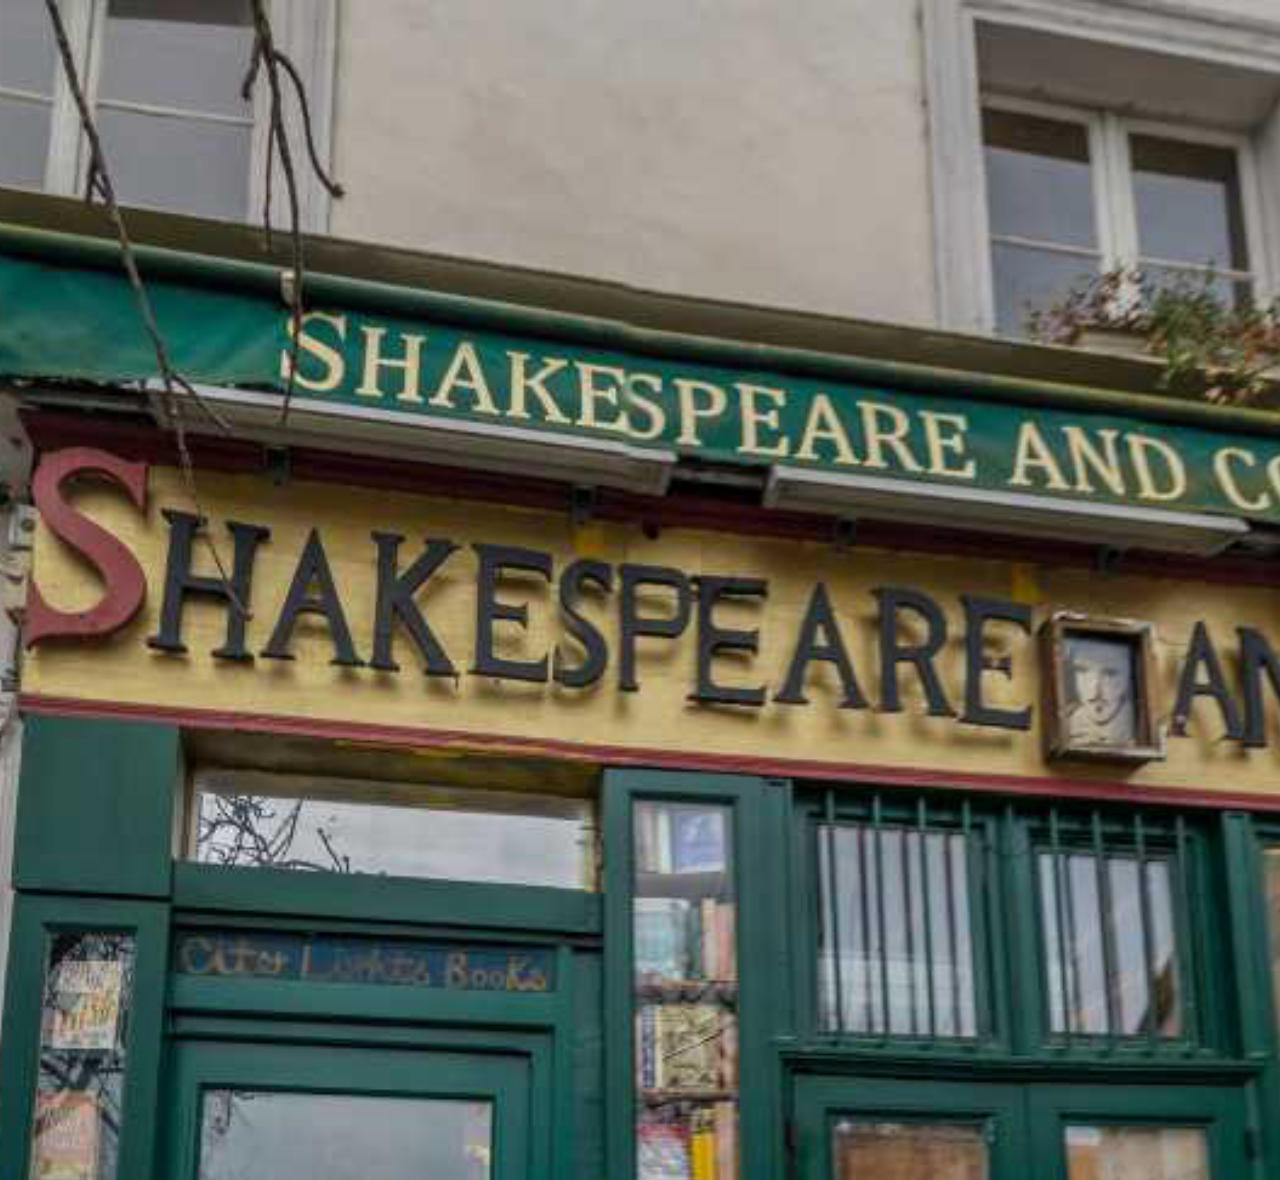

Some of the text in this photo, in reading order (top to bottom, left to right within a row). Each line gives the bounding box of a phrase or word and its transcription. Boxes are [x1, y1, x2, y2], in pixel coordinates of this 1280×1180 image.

[279, 309, 977, 481] SHAKESPEARE
[1007, 421, 1187, 500] AND
[22, 446, 1032, 730] SHAKESPEARE
